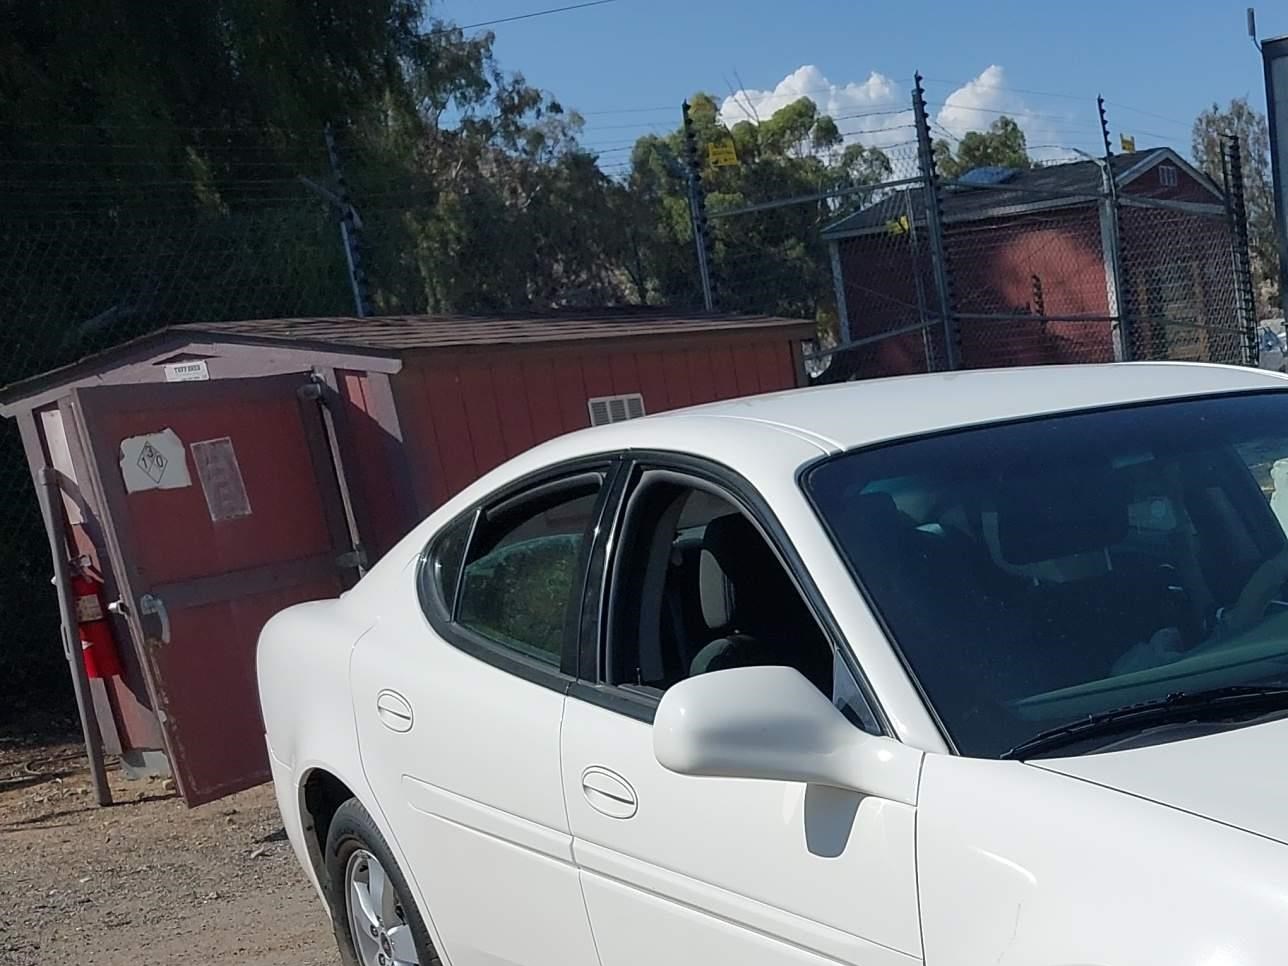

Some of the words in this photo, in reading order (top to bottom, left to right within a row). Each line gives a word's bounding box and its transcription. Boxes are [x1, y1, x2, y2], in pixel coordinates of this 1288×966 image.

[147, 444, 154, 458] 3
[142, 456, 149, 469] 1
[155, 454, 164, 468] 0
